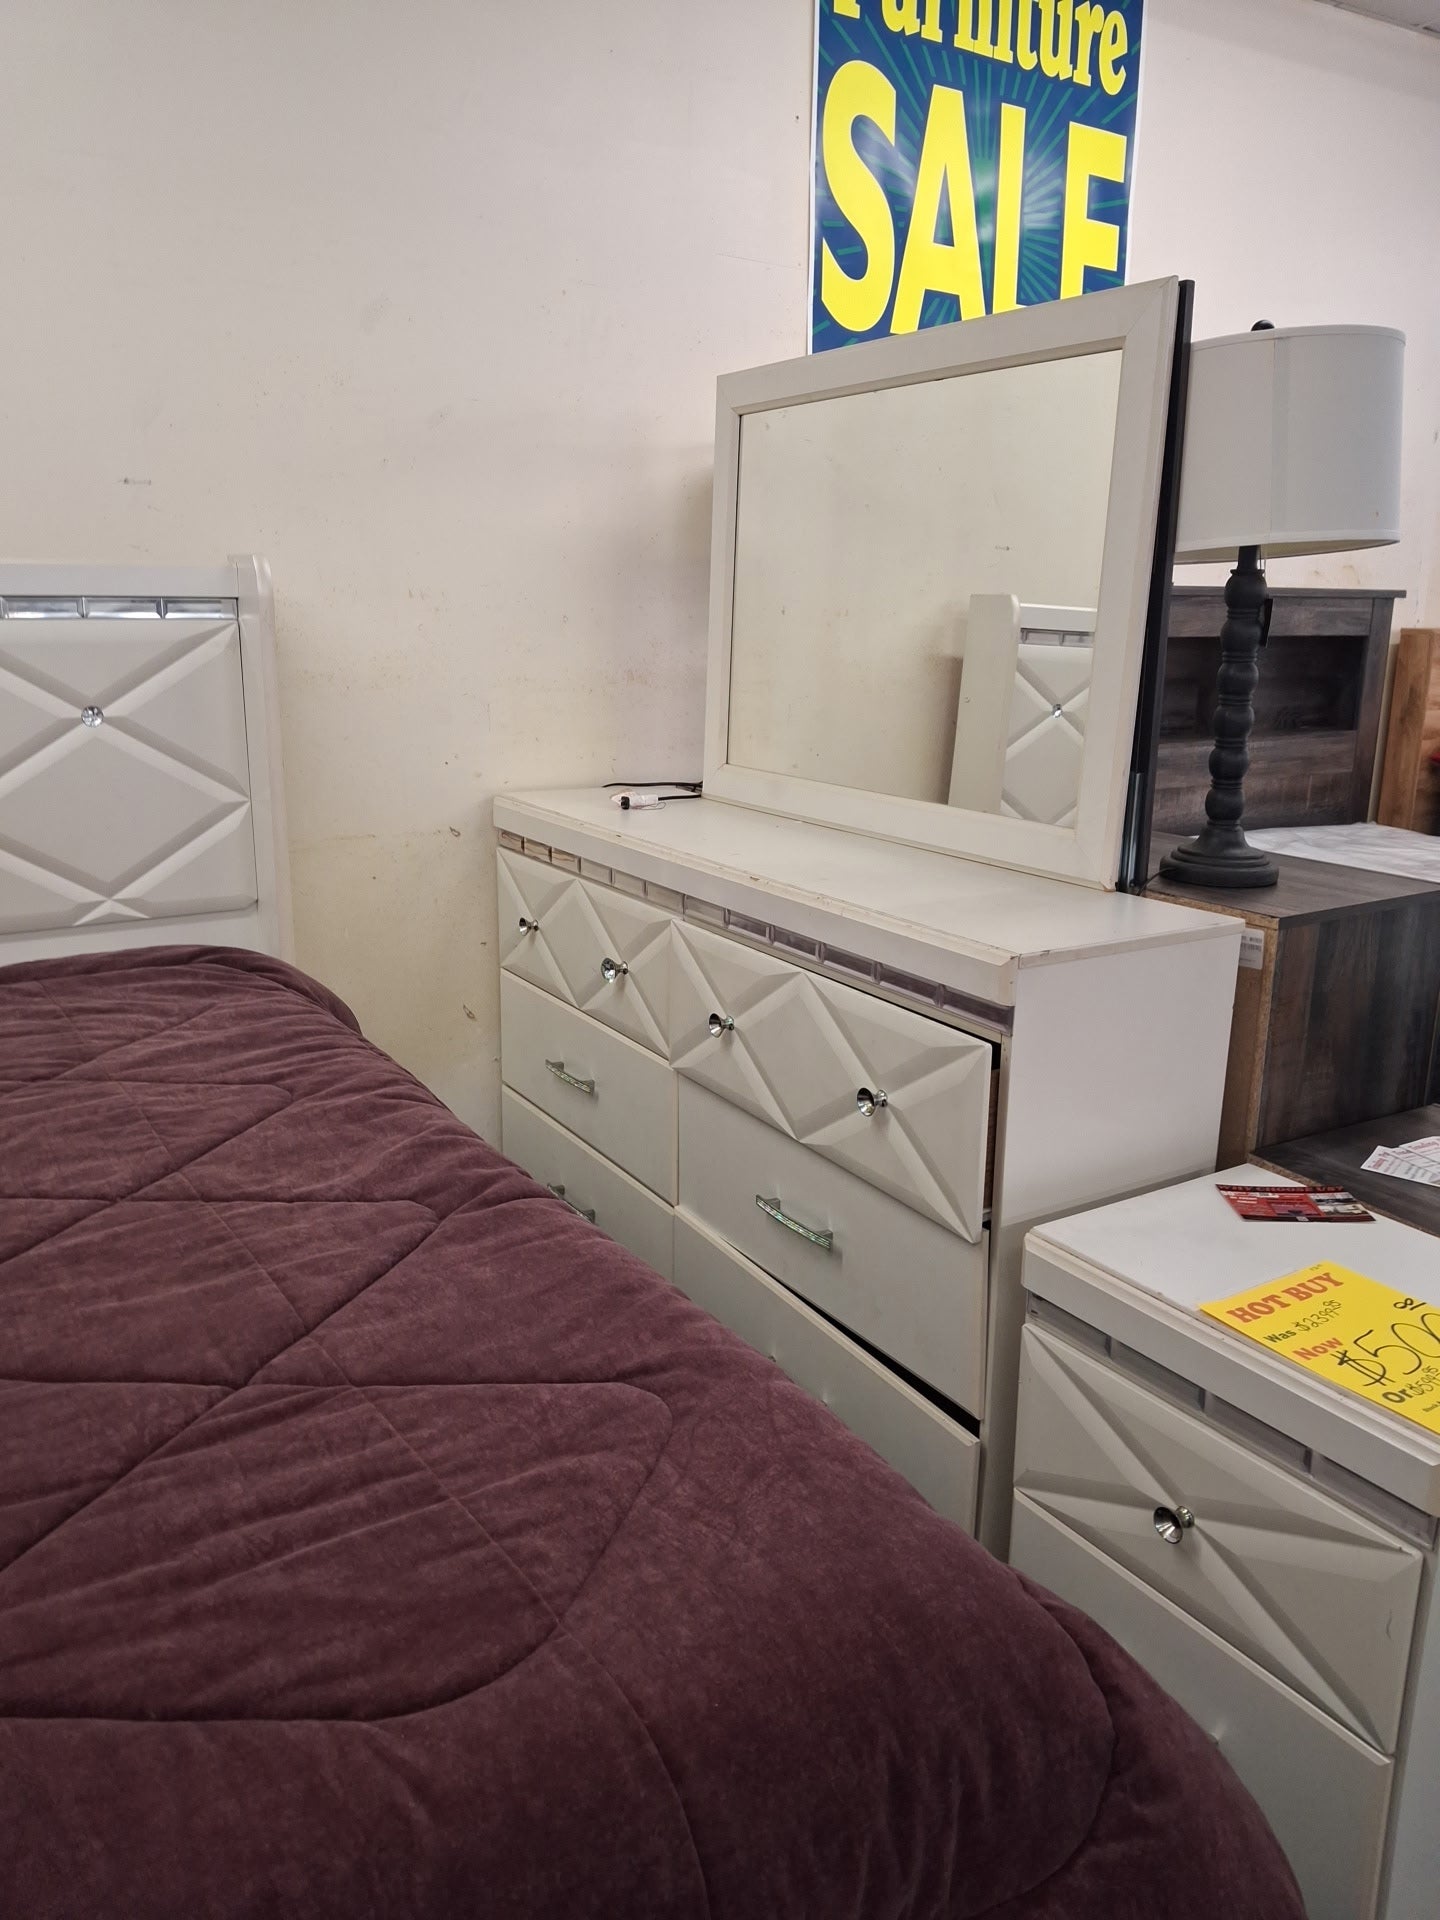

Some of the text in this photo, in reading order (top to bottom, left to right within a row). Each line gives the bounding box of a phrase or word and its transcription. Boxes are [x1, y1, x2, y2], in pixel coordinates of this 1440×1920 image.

[833, 0, 1128, 95] niture
[821, 60, 1128, 335] SALE
[1226, 1272, 1344, 1323] HOT BUY
[1263, 1330, 1297, 1343] Was
[1293, 1337, 1343, 1360] Now
[1382, 1389, 1413, 1403] Or
